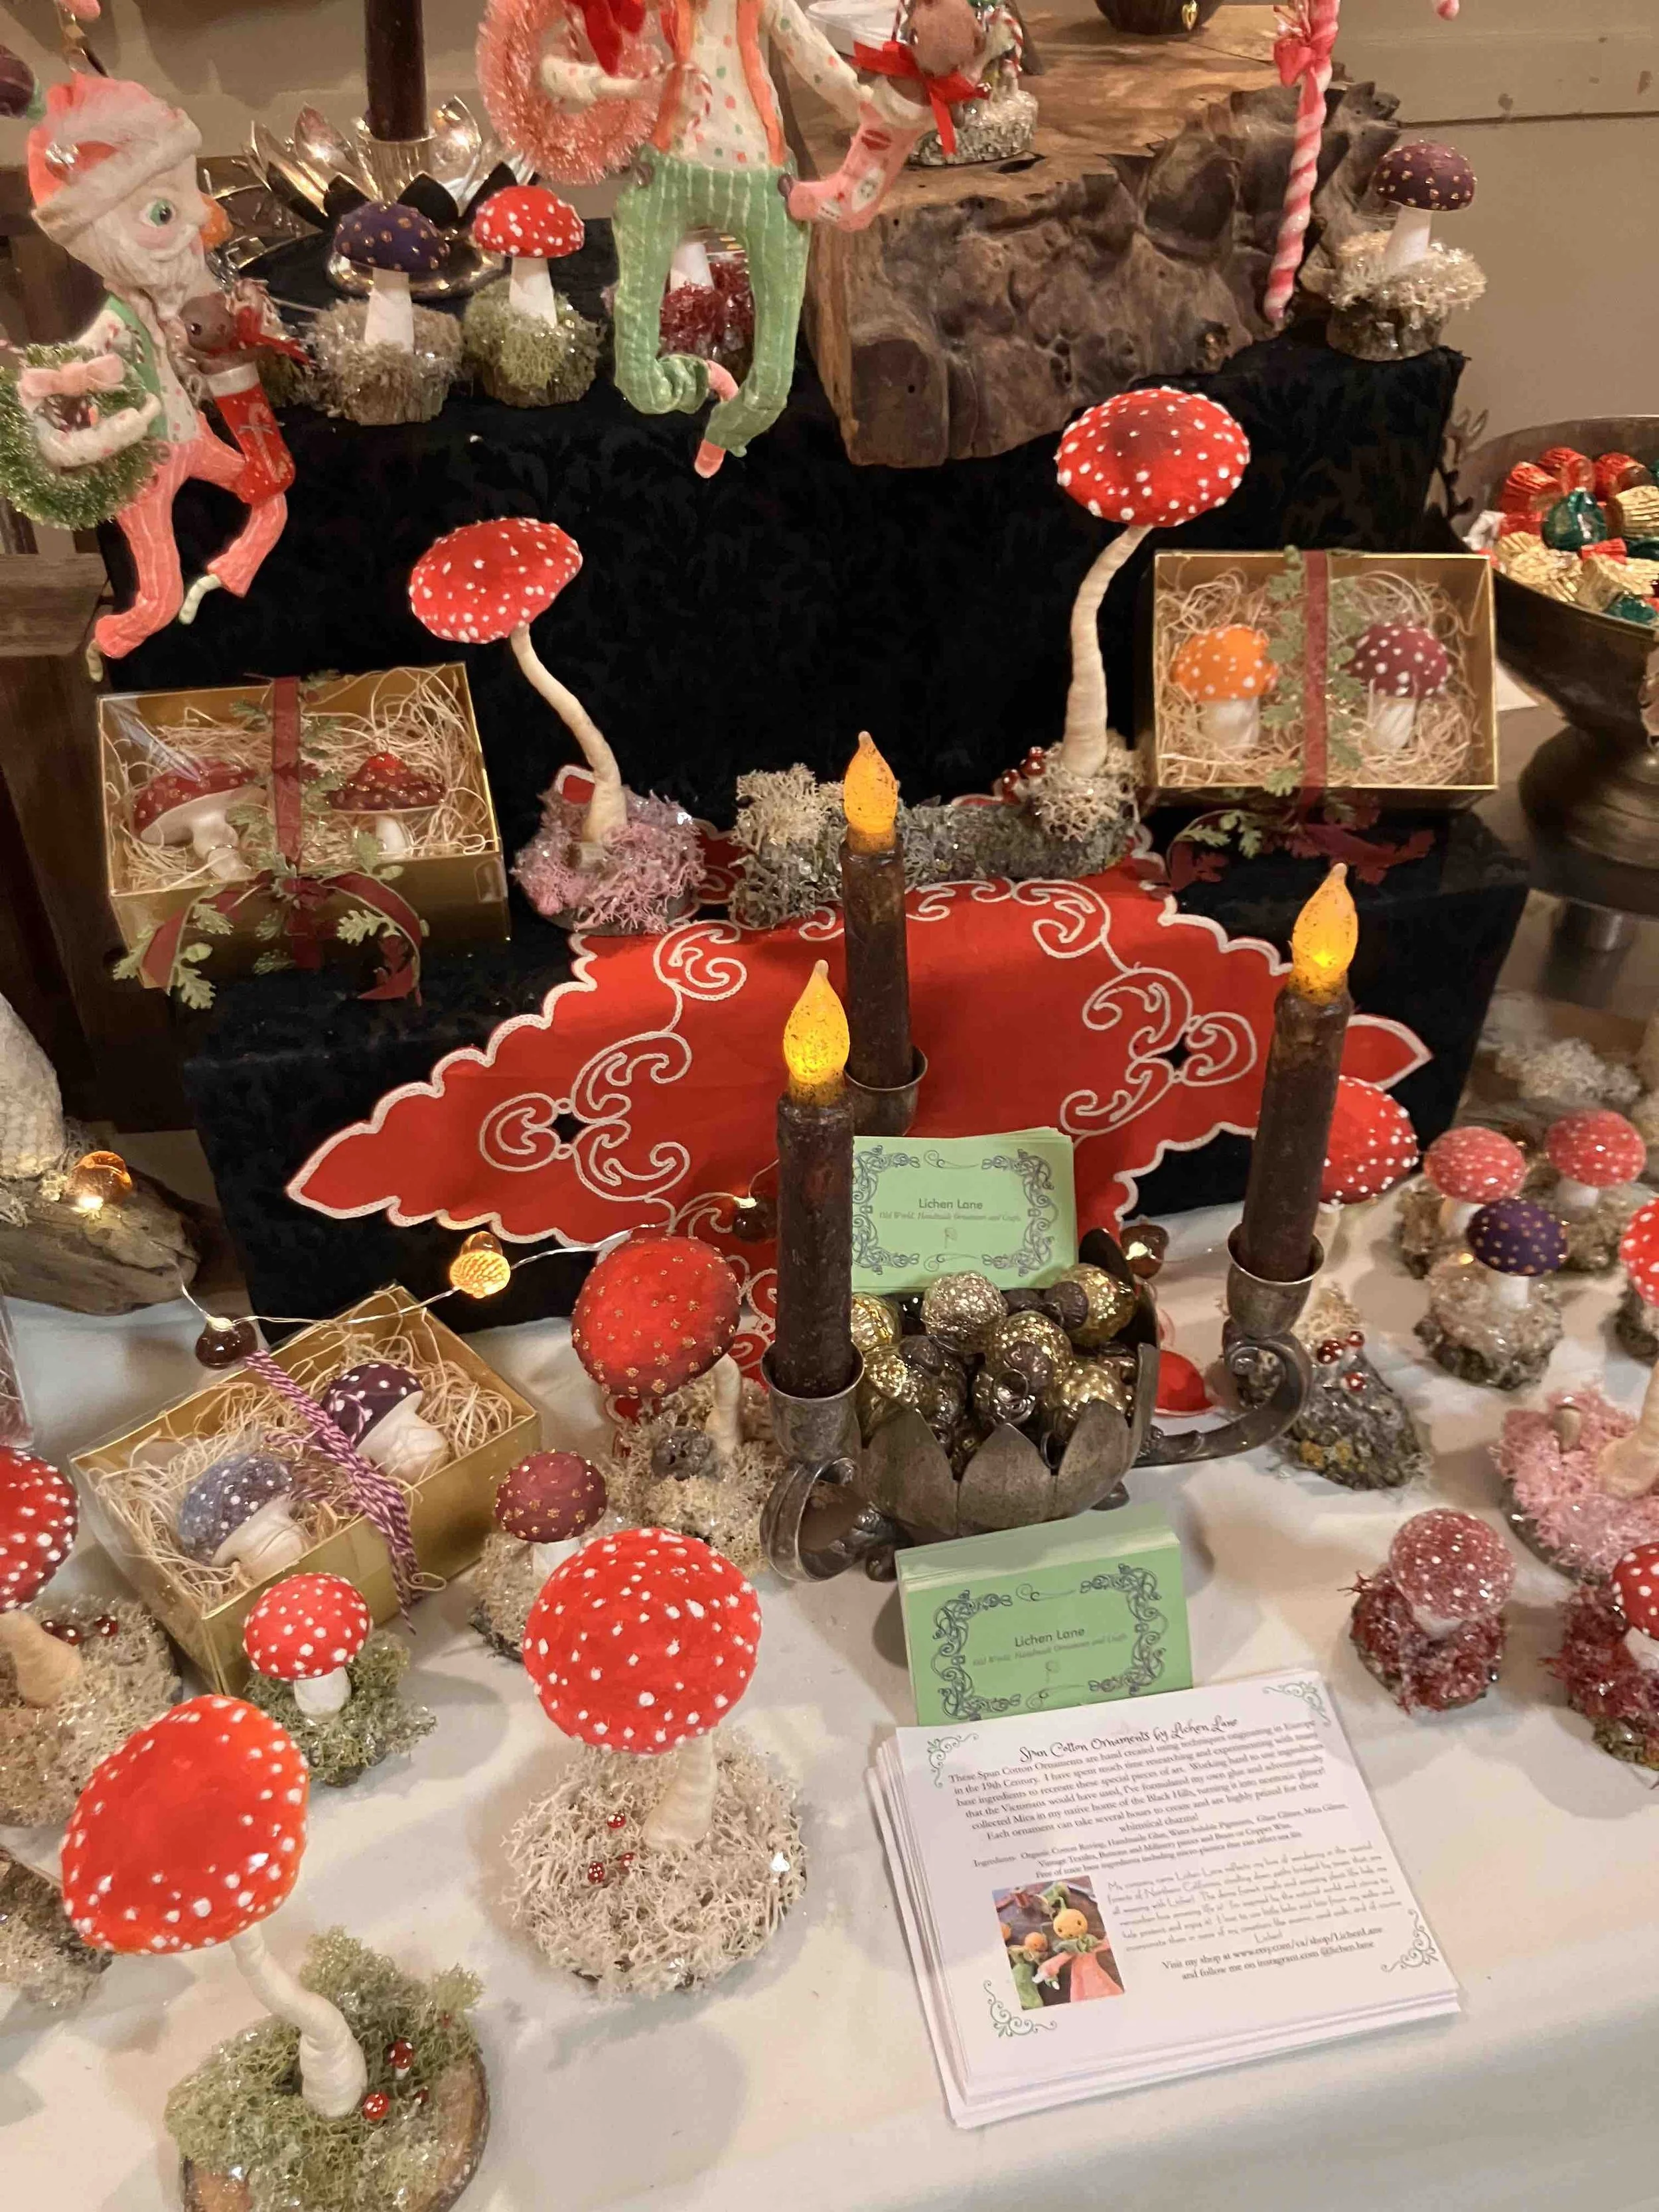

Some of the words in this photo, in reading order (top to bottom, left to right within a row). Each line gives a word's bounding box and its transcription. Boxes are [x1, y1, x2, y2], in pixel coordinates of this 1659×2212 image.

[918, 1198, 953, 1209] Lichen
[957, 1199, 983, 1209] Lane
[1015, 1633, 1052, 1648] Lichen
[1056, 1628, 1085, 1641] Lane
[1019, 1746, 1048, 1763] Spun
[1050, 1741, 1088, 1759] Cotton
[1090, 1730, 1151, 1750] Ornaments
[1153, 1726, 1169, 1742] by
[1171, 1719, 1210, 1739] Lichen
[1211, 1714, 1239, 1733] Lane
